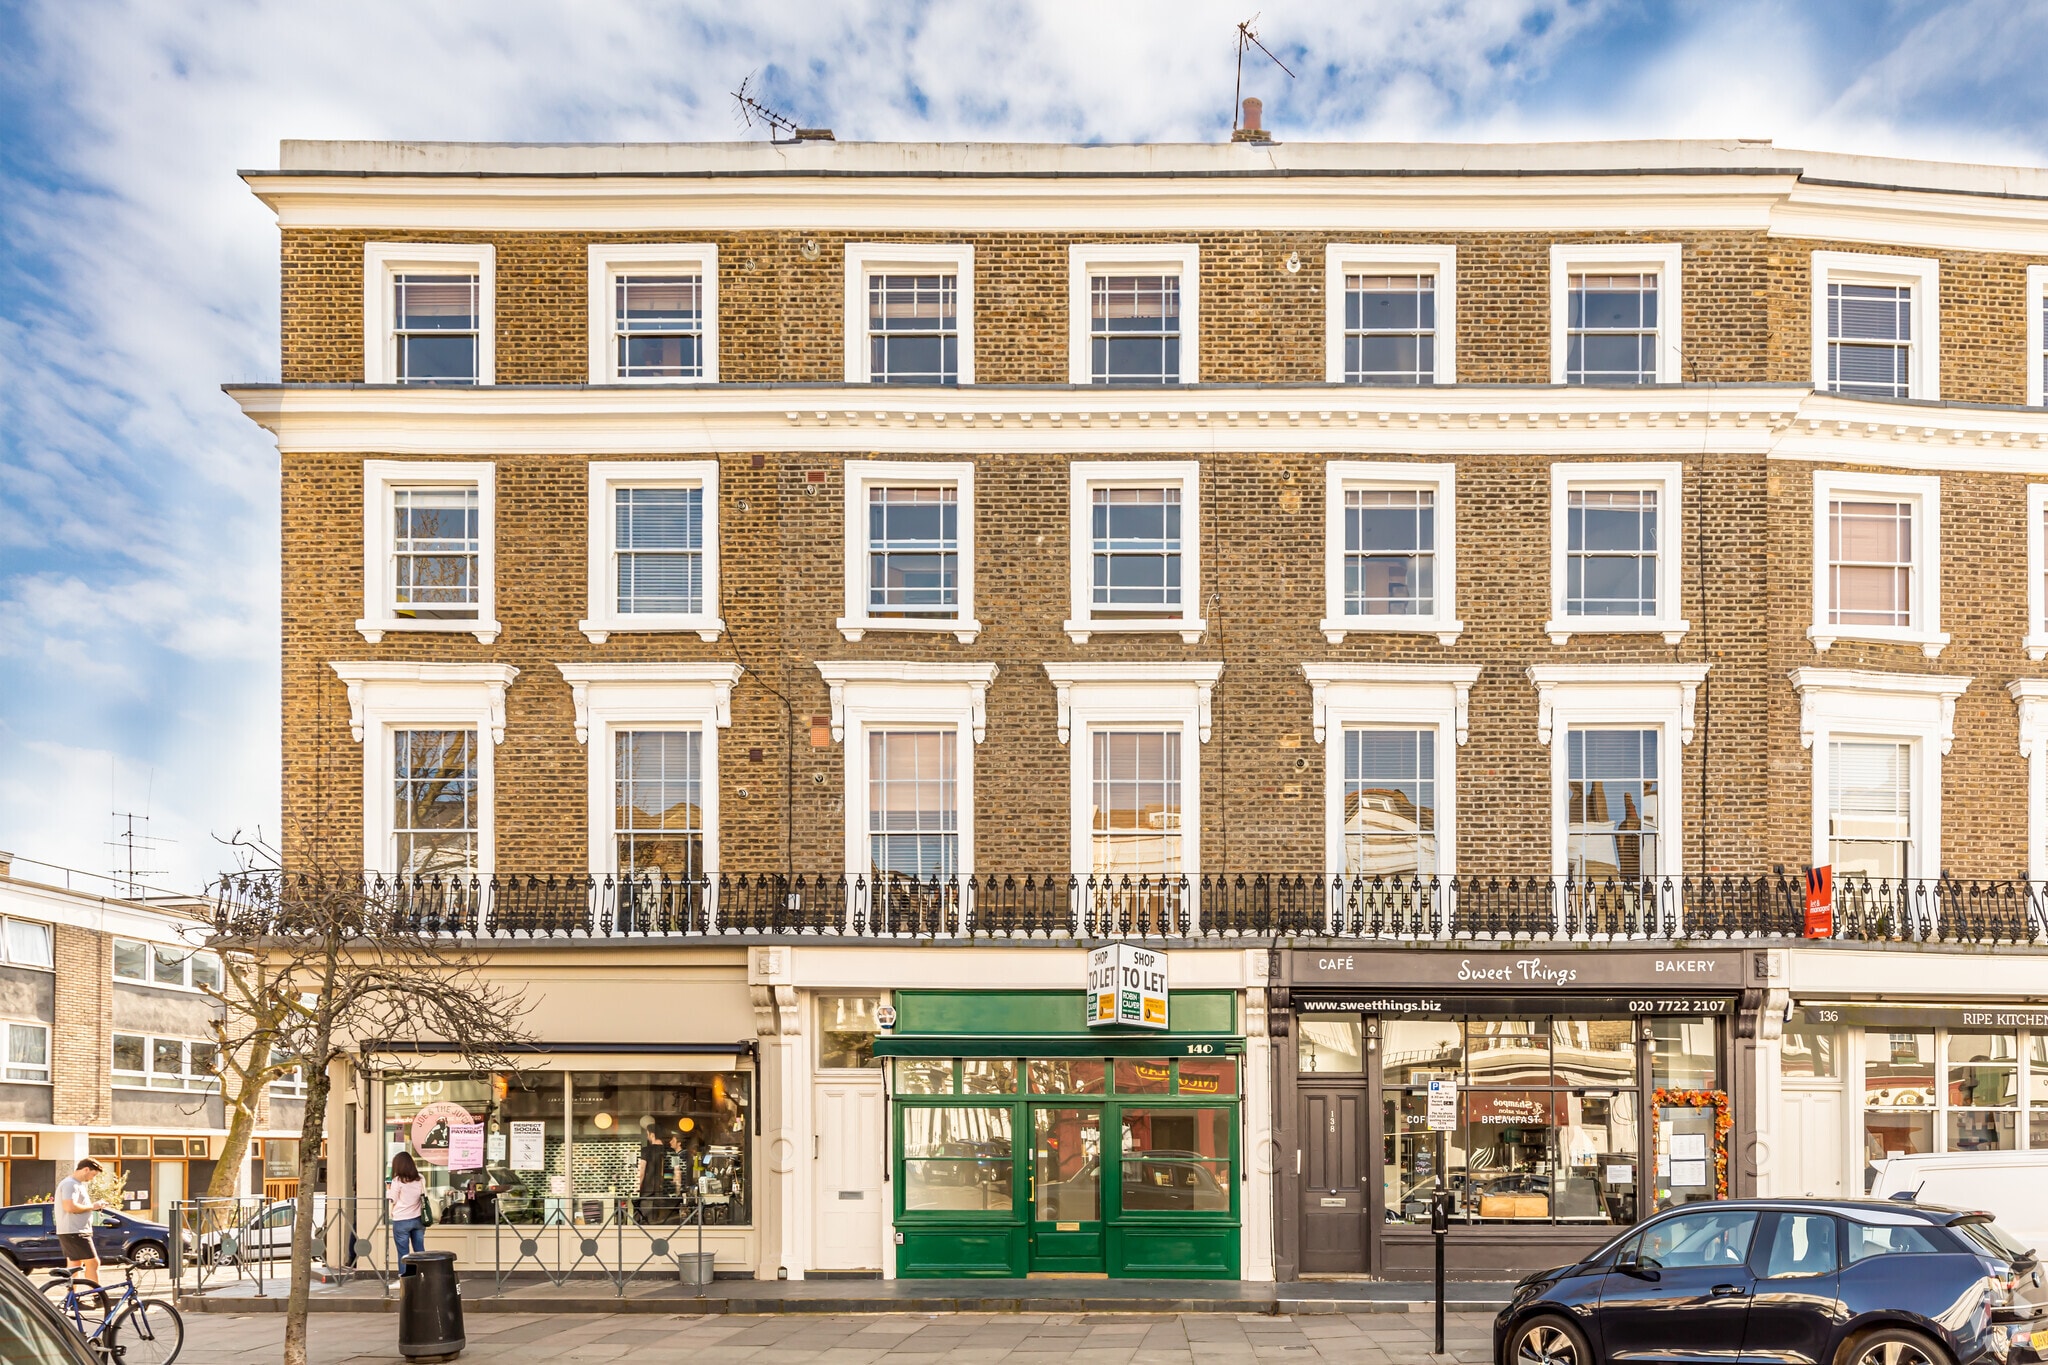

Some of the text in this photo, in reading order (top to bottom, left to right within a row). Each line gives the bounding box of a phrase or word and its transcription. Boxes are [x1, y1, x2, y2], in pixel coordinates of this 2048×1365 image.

[1095, 951, 1108, 966] SHOP
[1134, 952, 1154, 967] SHOP
[1319, 956, 1354, 970] CAFÉ
[1457, 957, 1577, 986] Sweet Things
[1655, 960, 1715, 971] BAKERY
[1089, 966, 1115, 991] TO LET
[1122, 966, 1165, 993] TO LET
[1123, 992, 1138, 1000] ROBIN
[1304, 1000, 1441, 1013] www.sweetthings.biz
[1629, 1001, 1726, 1011] 020 7722 2107
[1819, 1011, 1838, 1022] 136
[1963, 1013, 1992, 1024] RIPE
[1187, 1044, 1213, 1054] 140
[416, 1113, 428, 1128] JOE
[1407, 1115, 1426, 1124] COF
[1482, 1115, 1539, 1124] BREAKFAST
